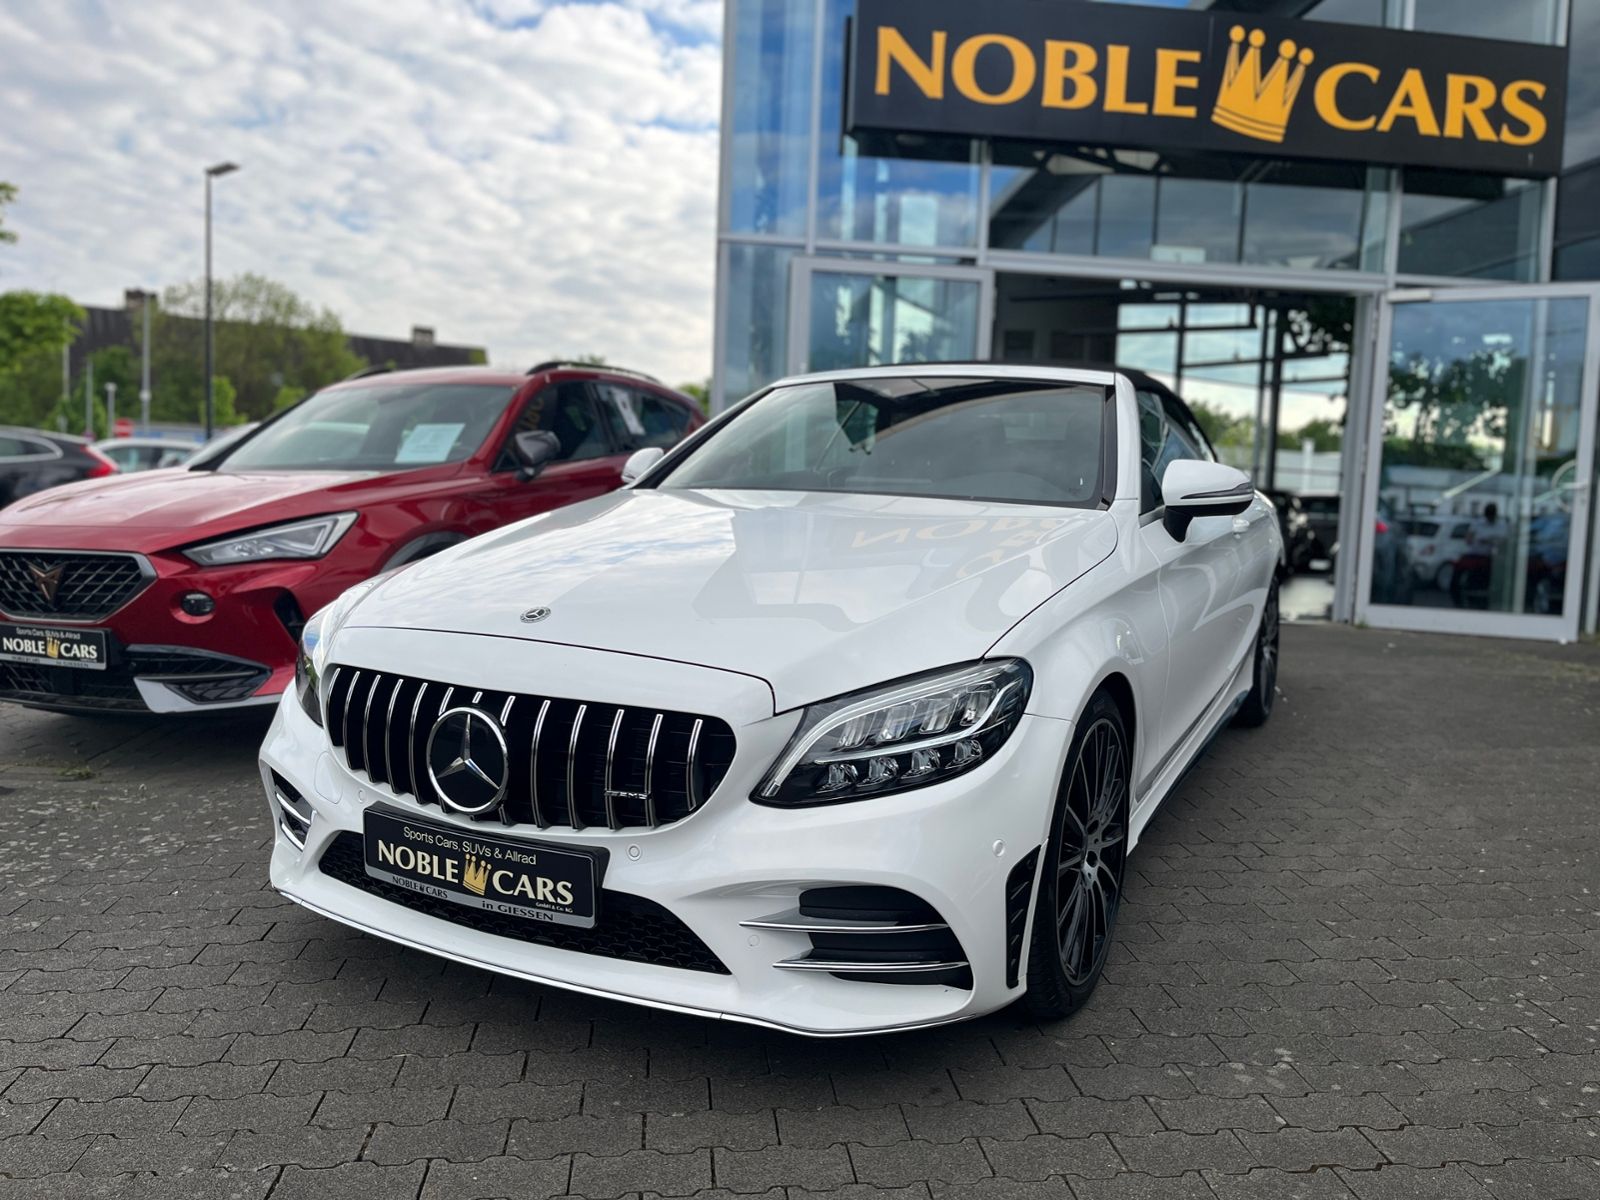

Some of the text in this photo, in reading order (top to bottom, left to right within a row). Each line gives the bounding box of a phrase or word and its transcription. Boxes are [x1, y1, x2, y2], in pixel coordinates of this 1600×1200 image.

[874, 26, 1547, 146] NOBLE CARS
[2, 636, 97, 659] NOBLE CARS
[403, 826, 537, 866] Sports Cars, SUVs & Allrad
[377, 839, 574, 905] NOBLE CARS
[392, 876, 448, 899] NOBLE CARS
[482, 900, 554, 921] in GIESSEN
